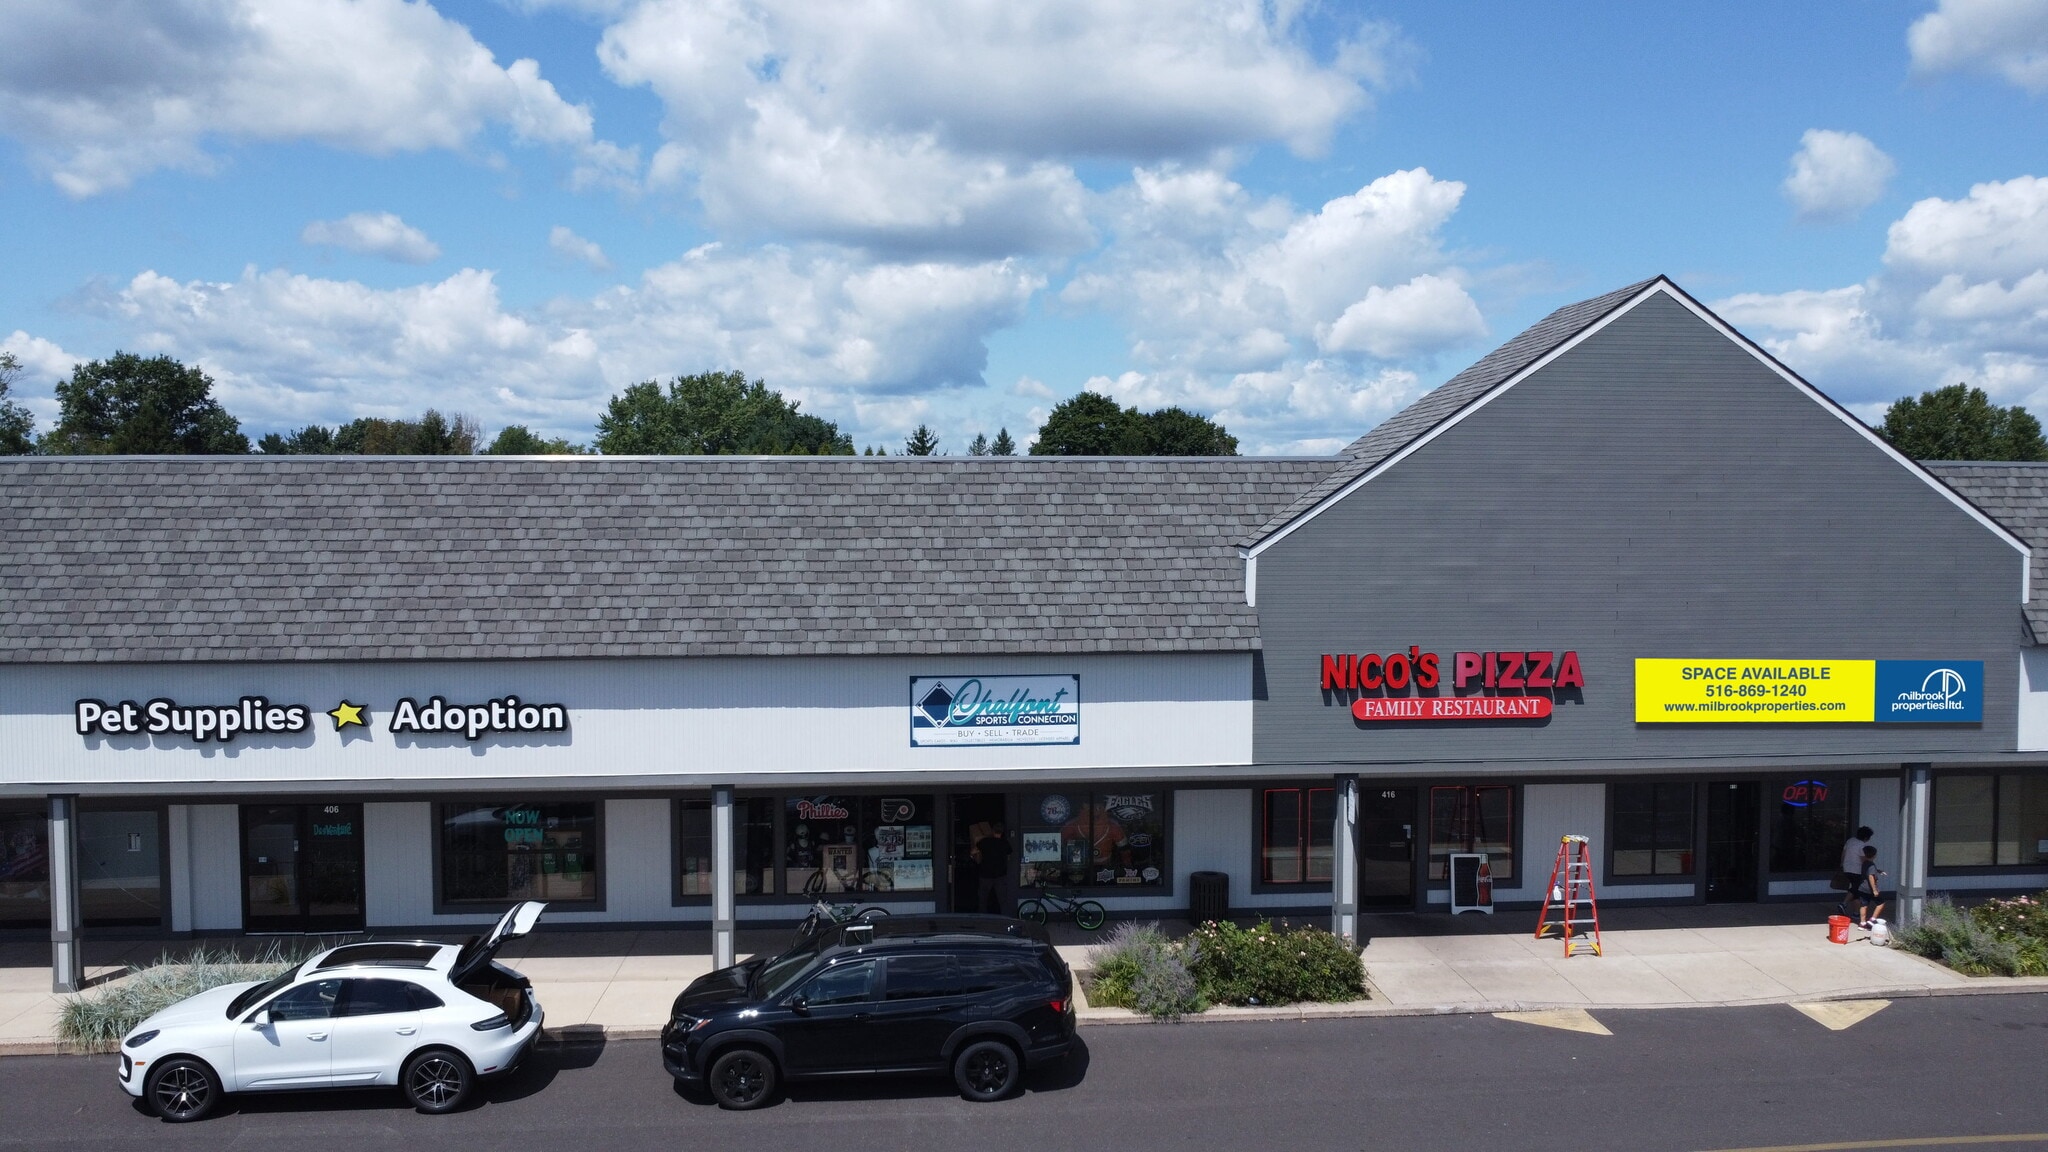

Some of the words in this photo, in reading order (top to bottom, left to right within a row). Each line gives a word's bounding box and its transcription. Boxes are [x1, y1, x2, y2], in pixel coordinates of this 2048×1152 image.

[1320, 645, 1440, 690] NICO'S
[1455, 651, 1585, 689] PIZZA
[1681, 667, 1737, 681] SPACE
[1741, 667, 1831, 680] AVAILABLE
[1705, 684, 1807, 697] 516-869-1240
[1897, 691, 1945, 700] milbrook
[1364, 700, 1425, 717] FAMILY
[1431, 699, 1541, 717] RESTAURANT
[1664, 701, 1846, 714] www.milbrookproperties.com
[1891, 700, 1944, 712] properties
[77, 700, 140, 734] Pet
[147, 699, 307, 741] Supplies
[391, 697, 565, 740] Adoption
[975, 716, 1008, 725] SPORTS
[1017, 714, 1076, 724] CONNECTION
[957, 730, 974, 738] BUY
[1381, 790, 1396, 799] 416
[324, 805, 339, 814] 406
[797, 800, 849, 820] Phillies
[1104, 795, 1154, 812] EAGLES
[504, 810, 540, 825] NOW
[504, 828, 544, 843] OPEN
